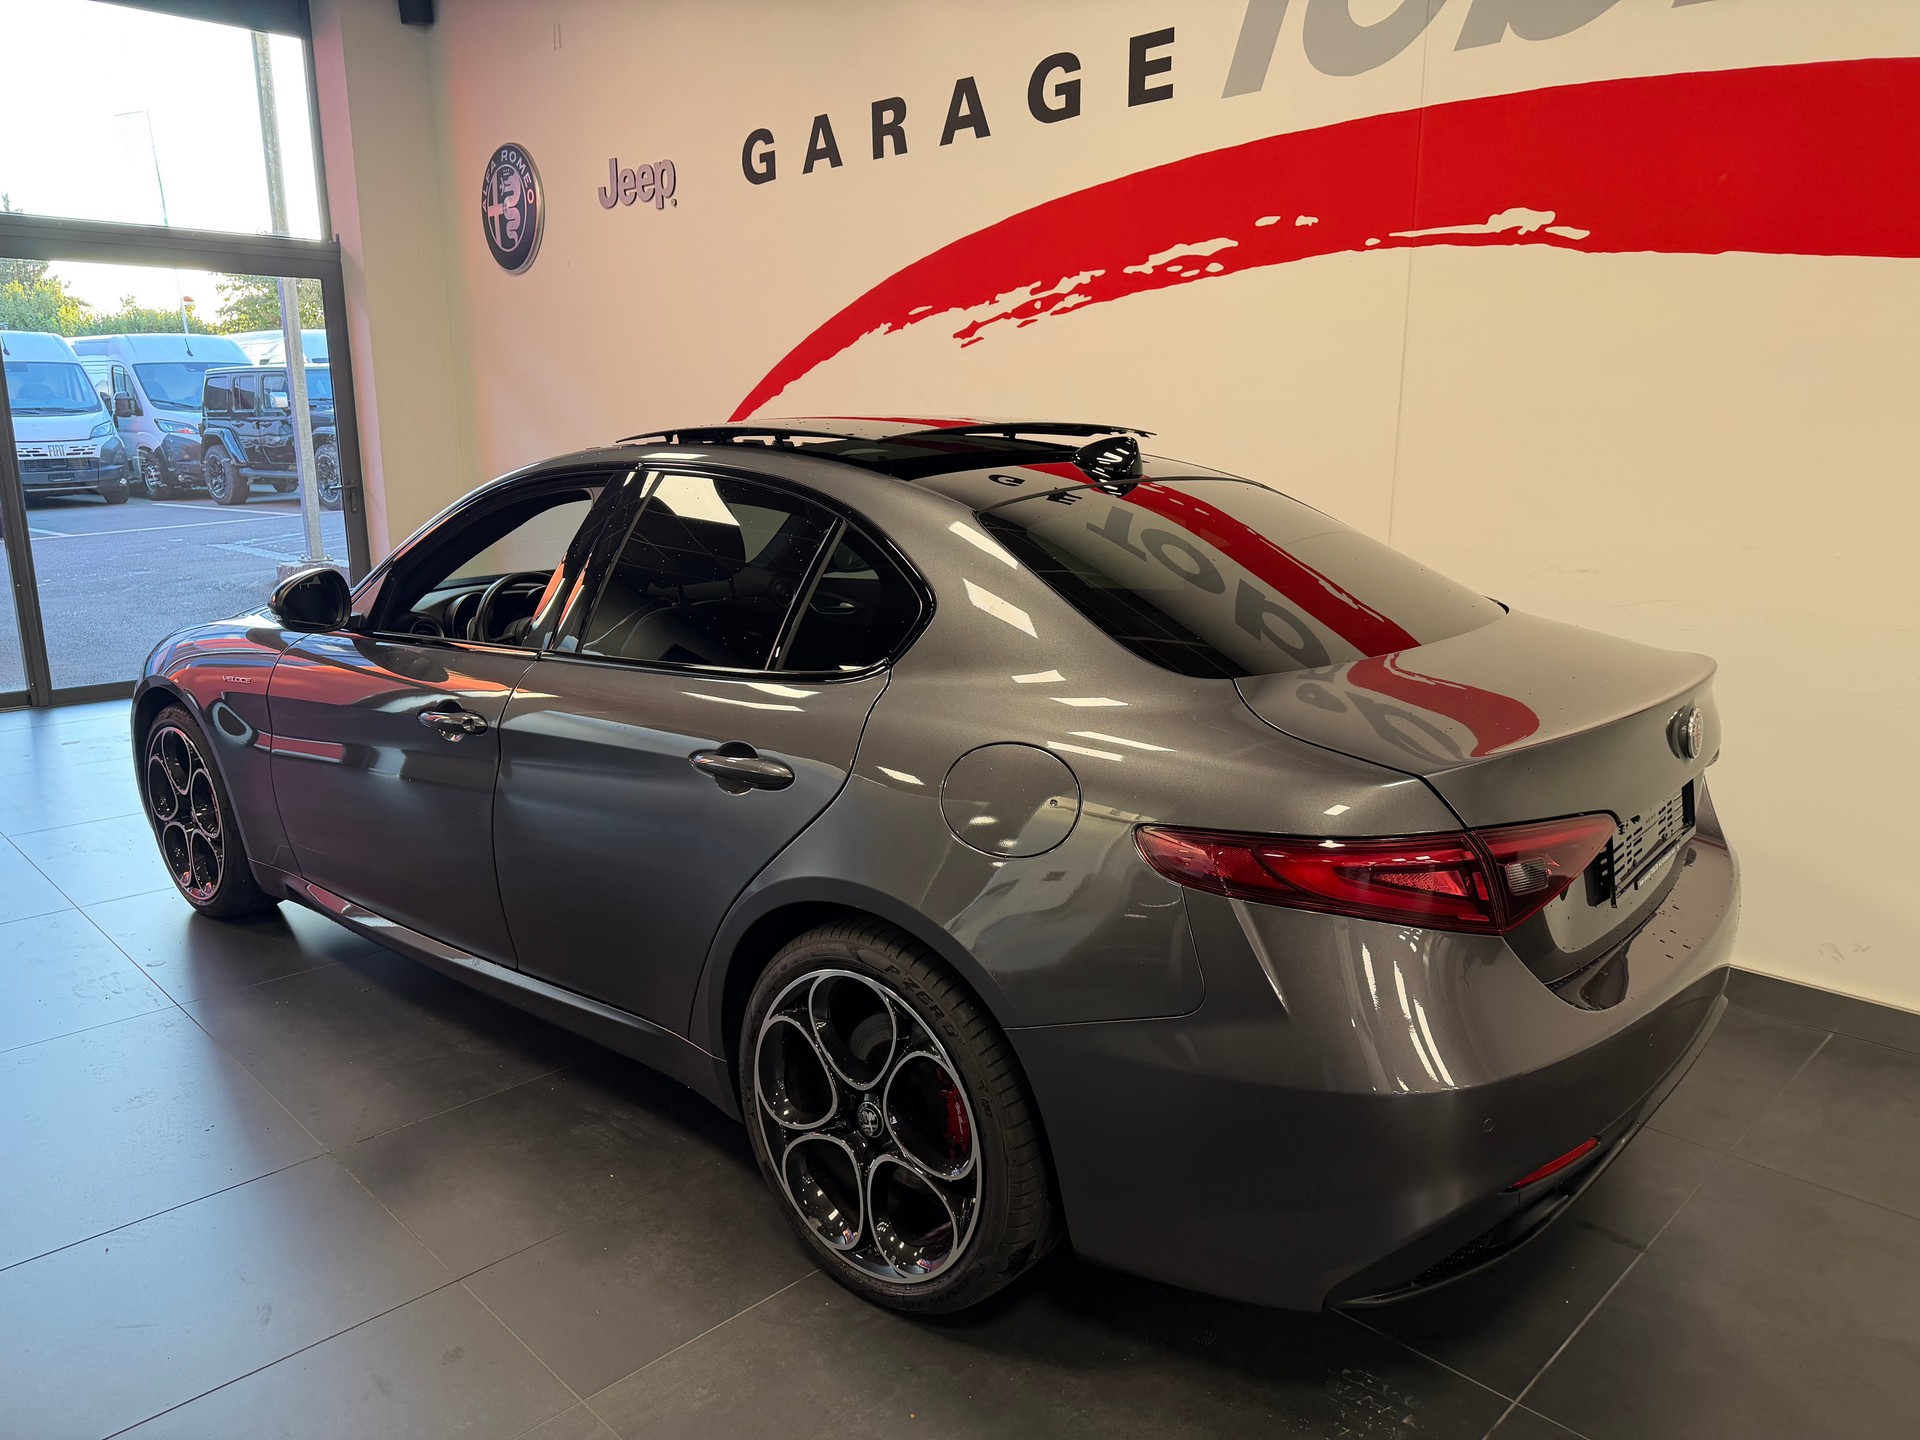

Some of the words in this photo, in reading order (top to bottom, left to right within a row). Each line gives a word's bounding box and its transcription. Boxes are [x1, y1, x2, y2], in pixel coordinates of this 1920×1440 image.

[742, 27, 1176, 185] GARAGE
[482, 160, 497, 213] ALFA
[501, 149, 535, 204] ROMEO
[47, 445, 65, 456] FIAT
[221, 675, 252, 684] VELOCE
